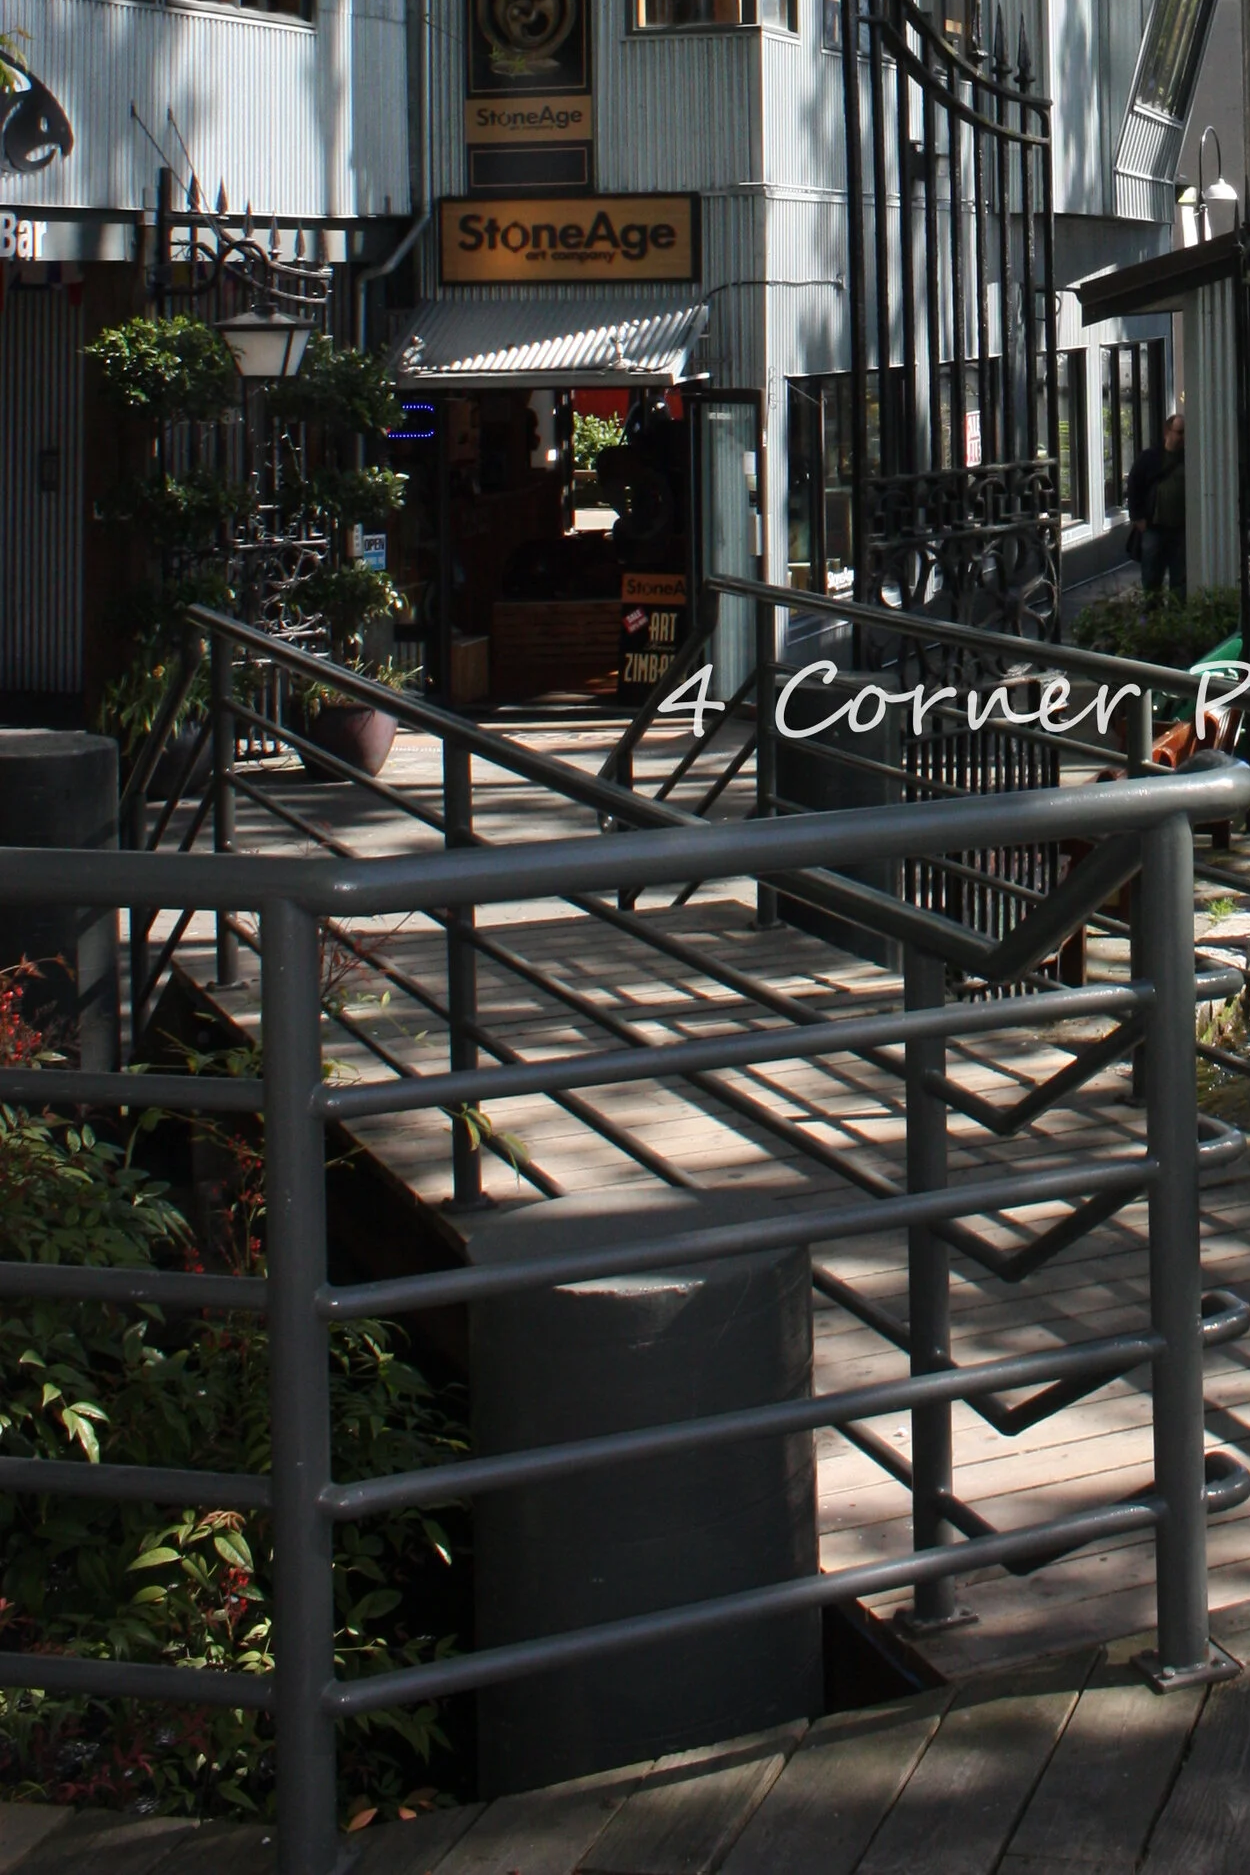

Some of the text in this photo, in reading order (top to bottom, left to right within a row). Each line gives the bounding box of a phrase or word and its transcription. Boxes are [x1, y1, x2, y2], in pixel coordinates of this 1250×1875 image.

[475, 105, 583, 129] StoneAge
[0, 212, 47, 261] Bar
[458, 211, 677, 261] StoneAge
[525, 249, 616, 264] art company
[648, 612, 678, 642] ART
[623, 653, 676, 684] ZIMBA
